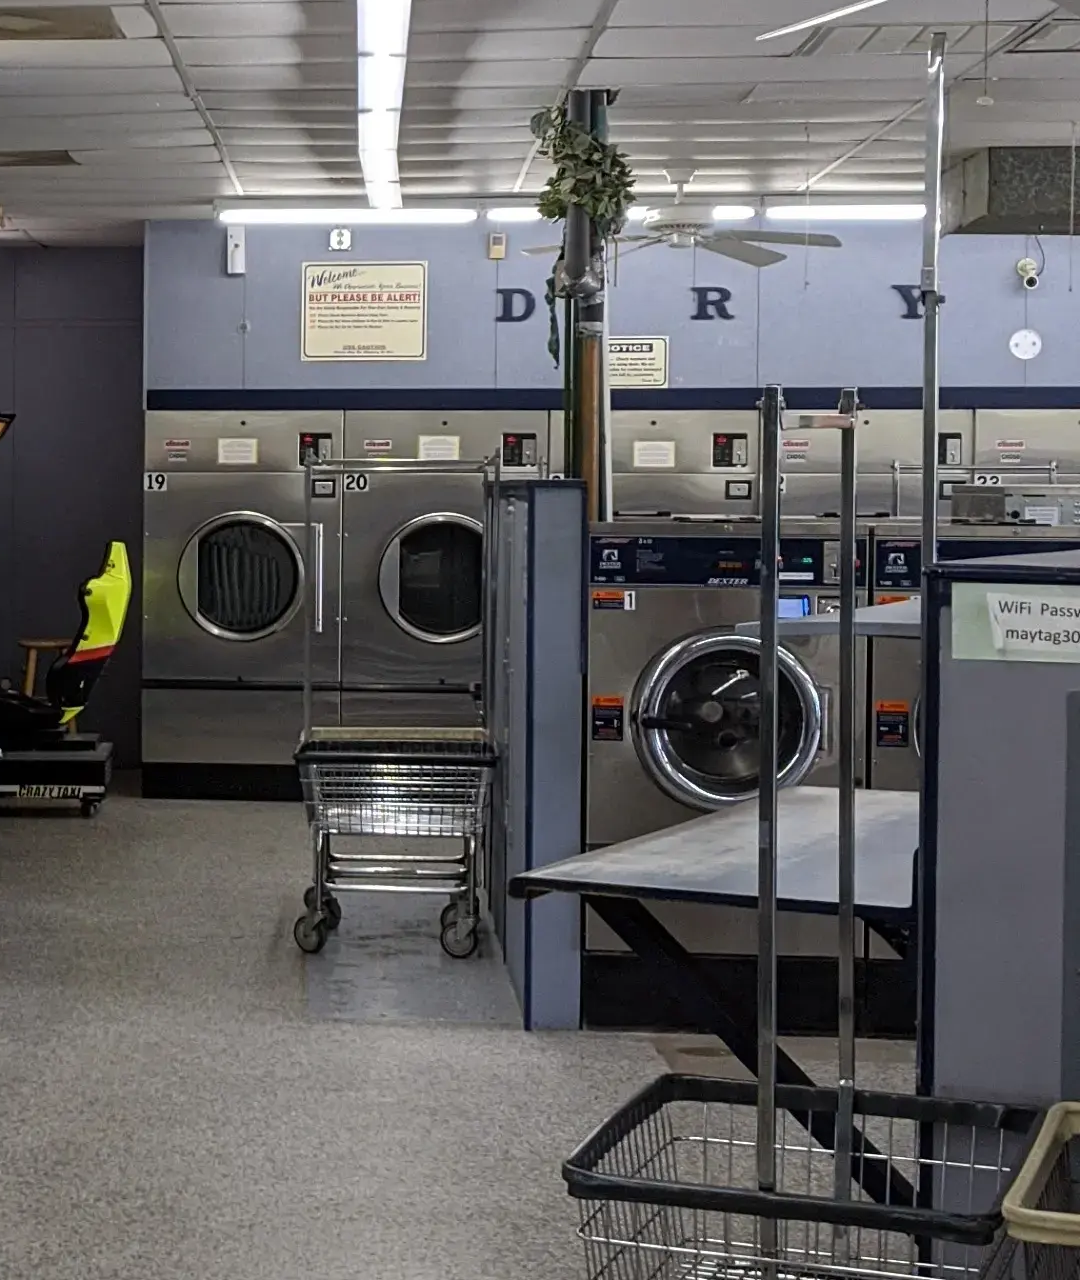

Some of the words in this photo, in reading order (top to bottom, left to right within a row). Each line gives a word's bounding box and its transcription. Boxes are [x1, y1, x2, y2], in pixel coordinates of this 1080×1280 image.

[309, 294, 328, 302] BUT
[331, 294, 368, 302] PLEASE
[371, 294, 384, 302] BE
[387, 293, 420, 302] ALERT!
[495, 288, 536, 322] D
[690, 287, 735, 320] R
[891, 284, 923, 319] Y
[147, 474, 165, 490] 19
[345, 475, 367, 490] 20
[707, 577, 748, 585] DEXTER
[627, 593, 633, 609] 1
[998, 600, 1031, 615] WiFi
[19, 784, 53, 798] CRAZY
